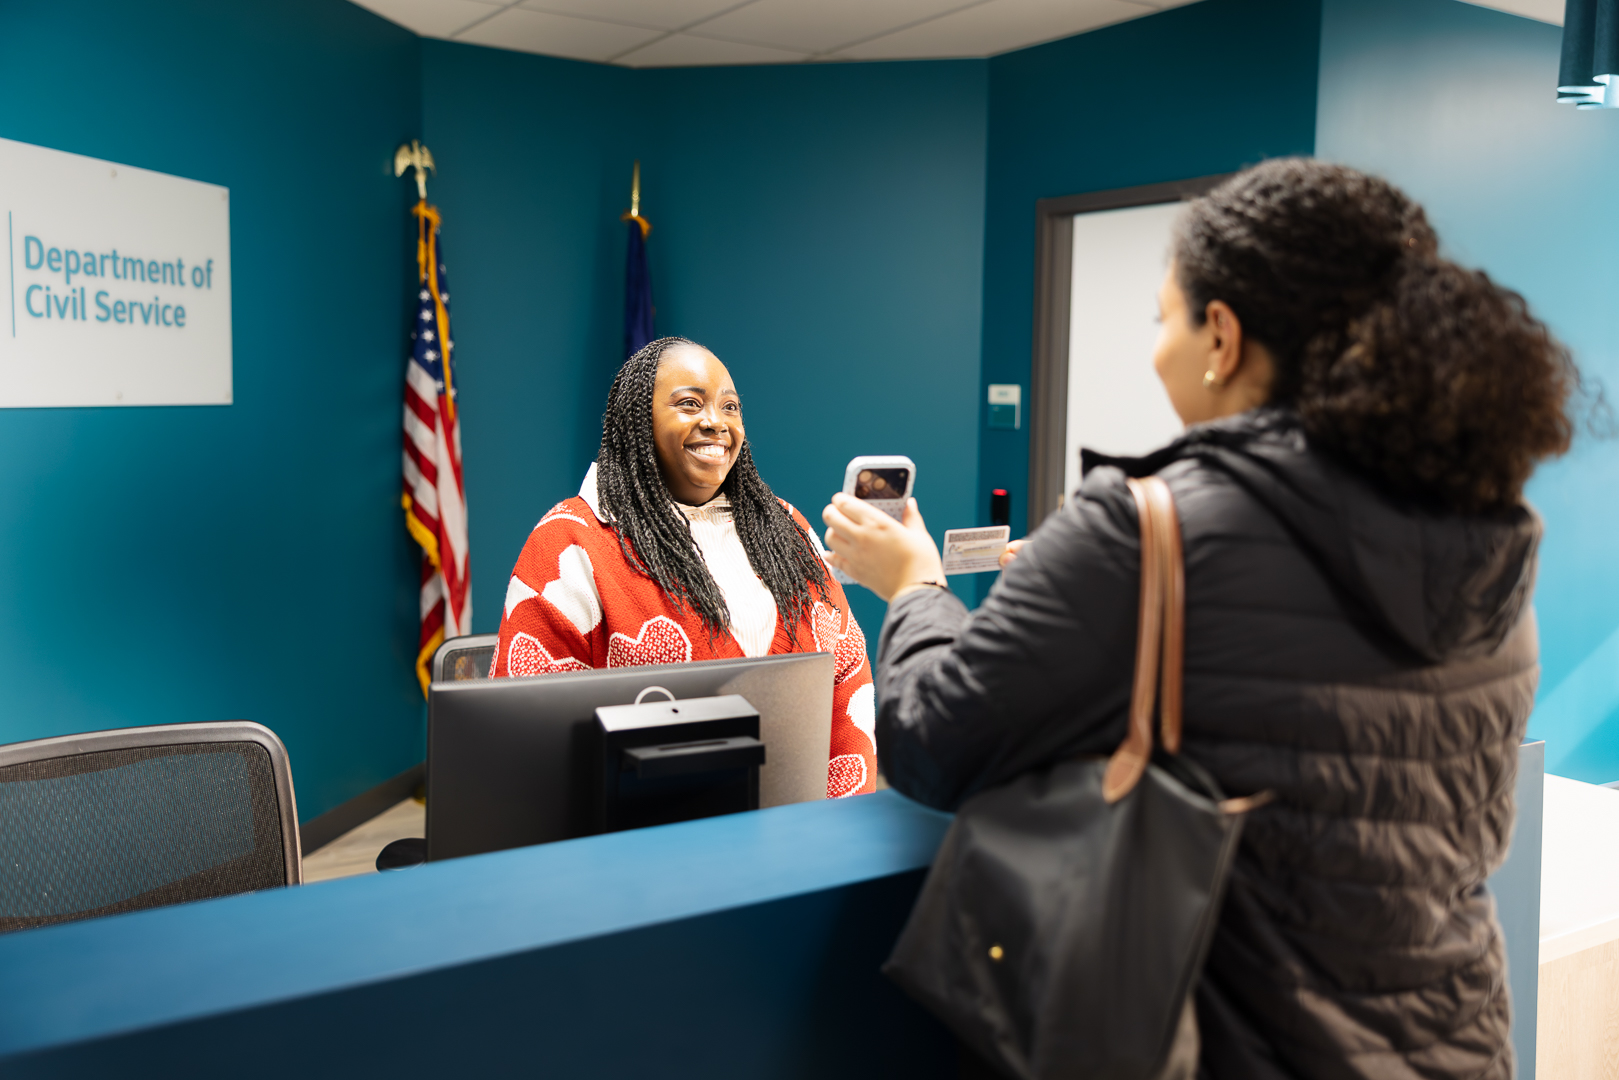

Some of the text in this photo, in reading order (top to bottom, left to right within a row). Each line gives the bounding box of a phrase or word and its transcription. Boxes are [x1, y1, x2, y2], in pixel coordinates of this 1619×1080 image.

[24, 235, 214, 289] Department of
[25, 284, 187, 327] Civil Service
